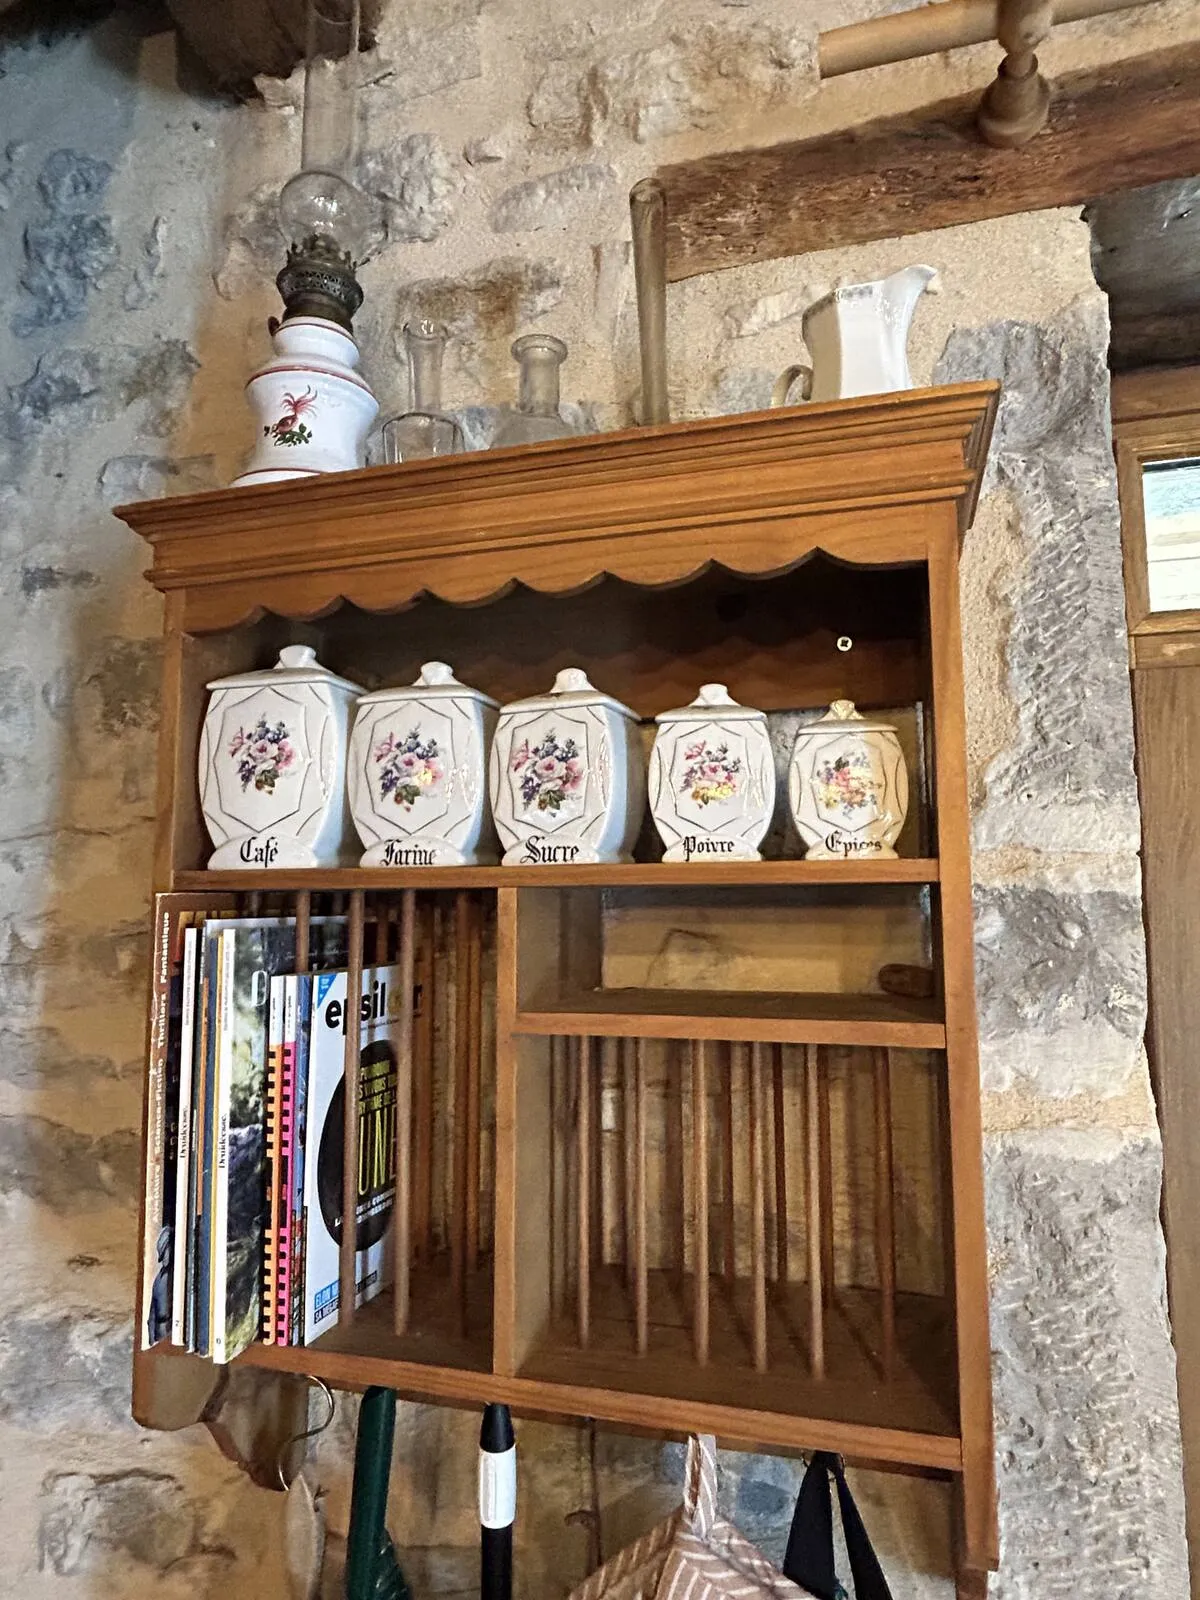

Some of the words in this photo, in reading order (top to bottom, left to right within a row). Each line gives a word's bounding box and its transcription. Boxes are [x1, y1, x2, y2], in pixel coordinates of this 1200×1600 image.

[240, 836, 278, 868] Café
[379, 839, 437, 867] Farine
[519, 835, 580, 864] Sucre
[682, 837, 734, 863] Poivre
[160, 911, 170, 984] Fantastique
[157, 993, 167, 1049] Thrillers
